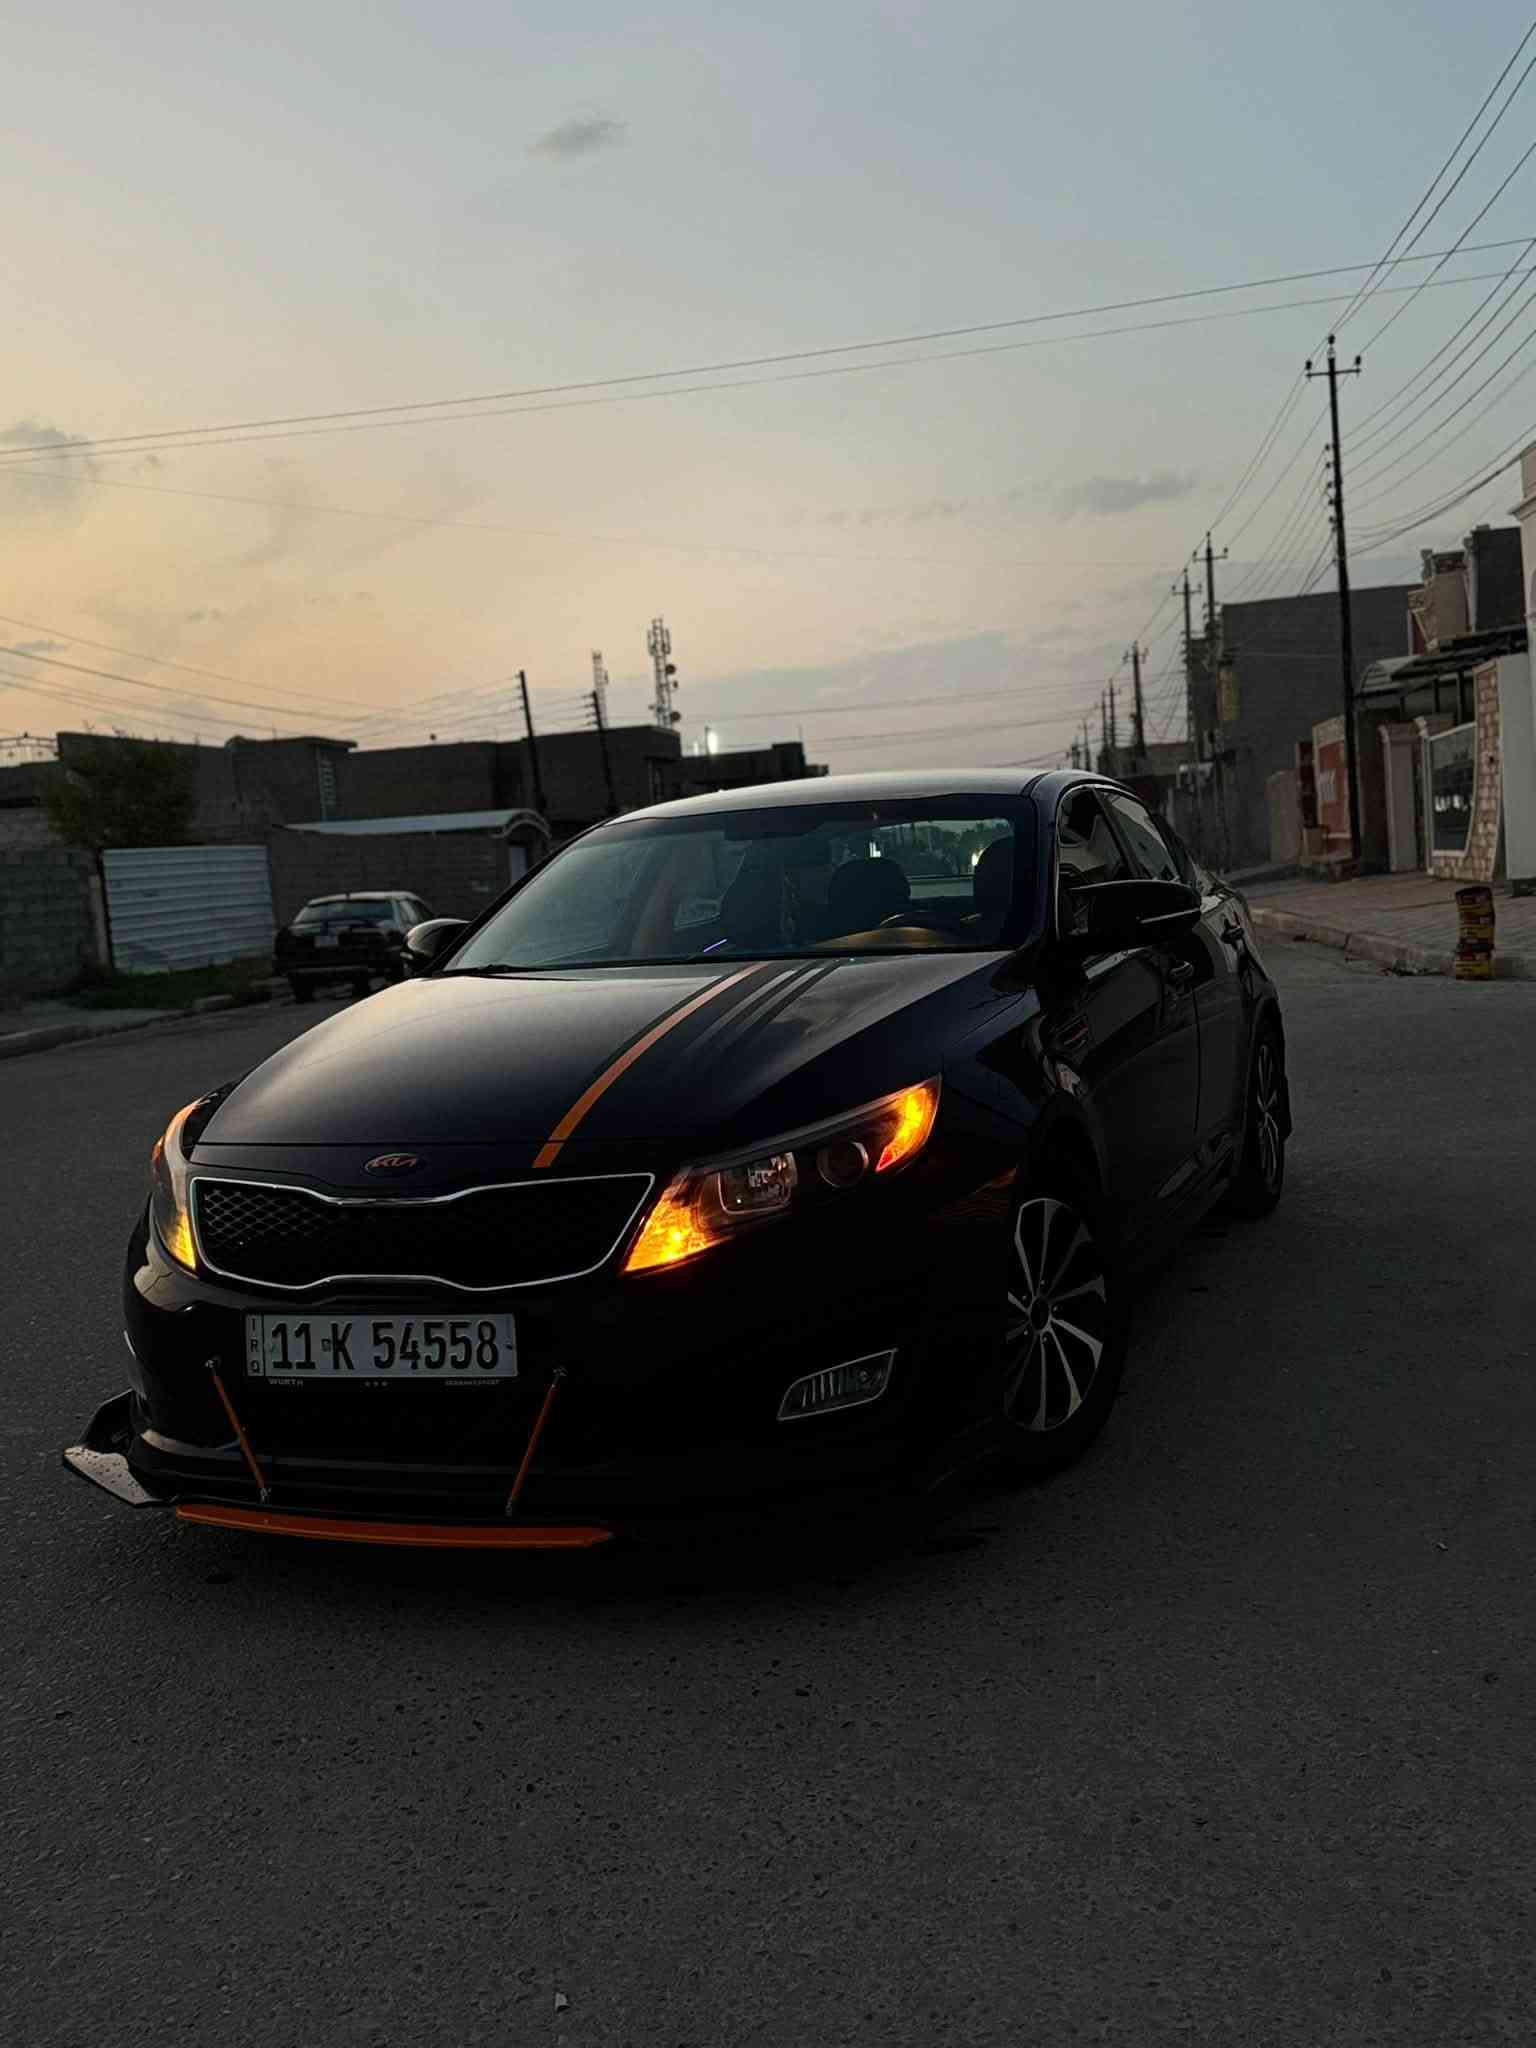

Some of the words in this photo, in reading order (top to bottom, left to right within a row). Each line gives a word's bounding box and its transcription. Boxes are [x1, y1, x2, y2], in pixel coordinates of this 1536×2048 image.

[271, 1322, 316, 1369] 11
[331, 1322, 355, 1370] K
[371, 1321, 499, 1370] 54558
